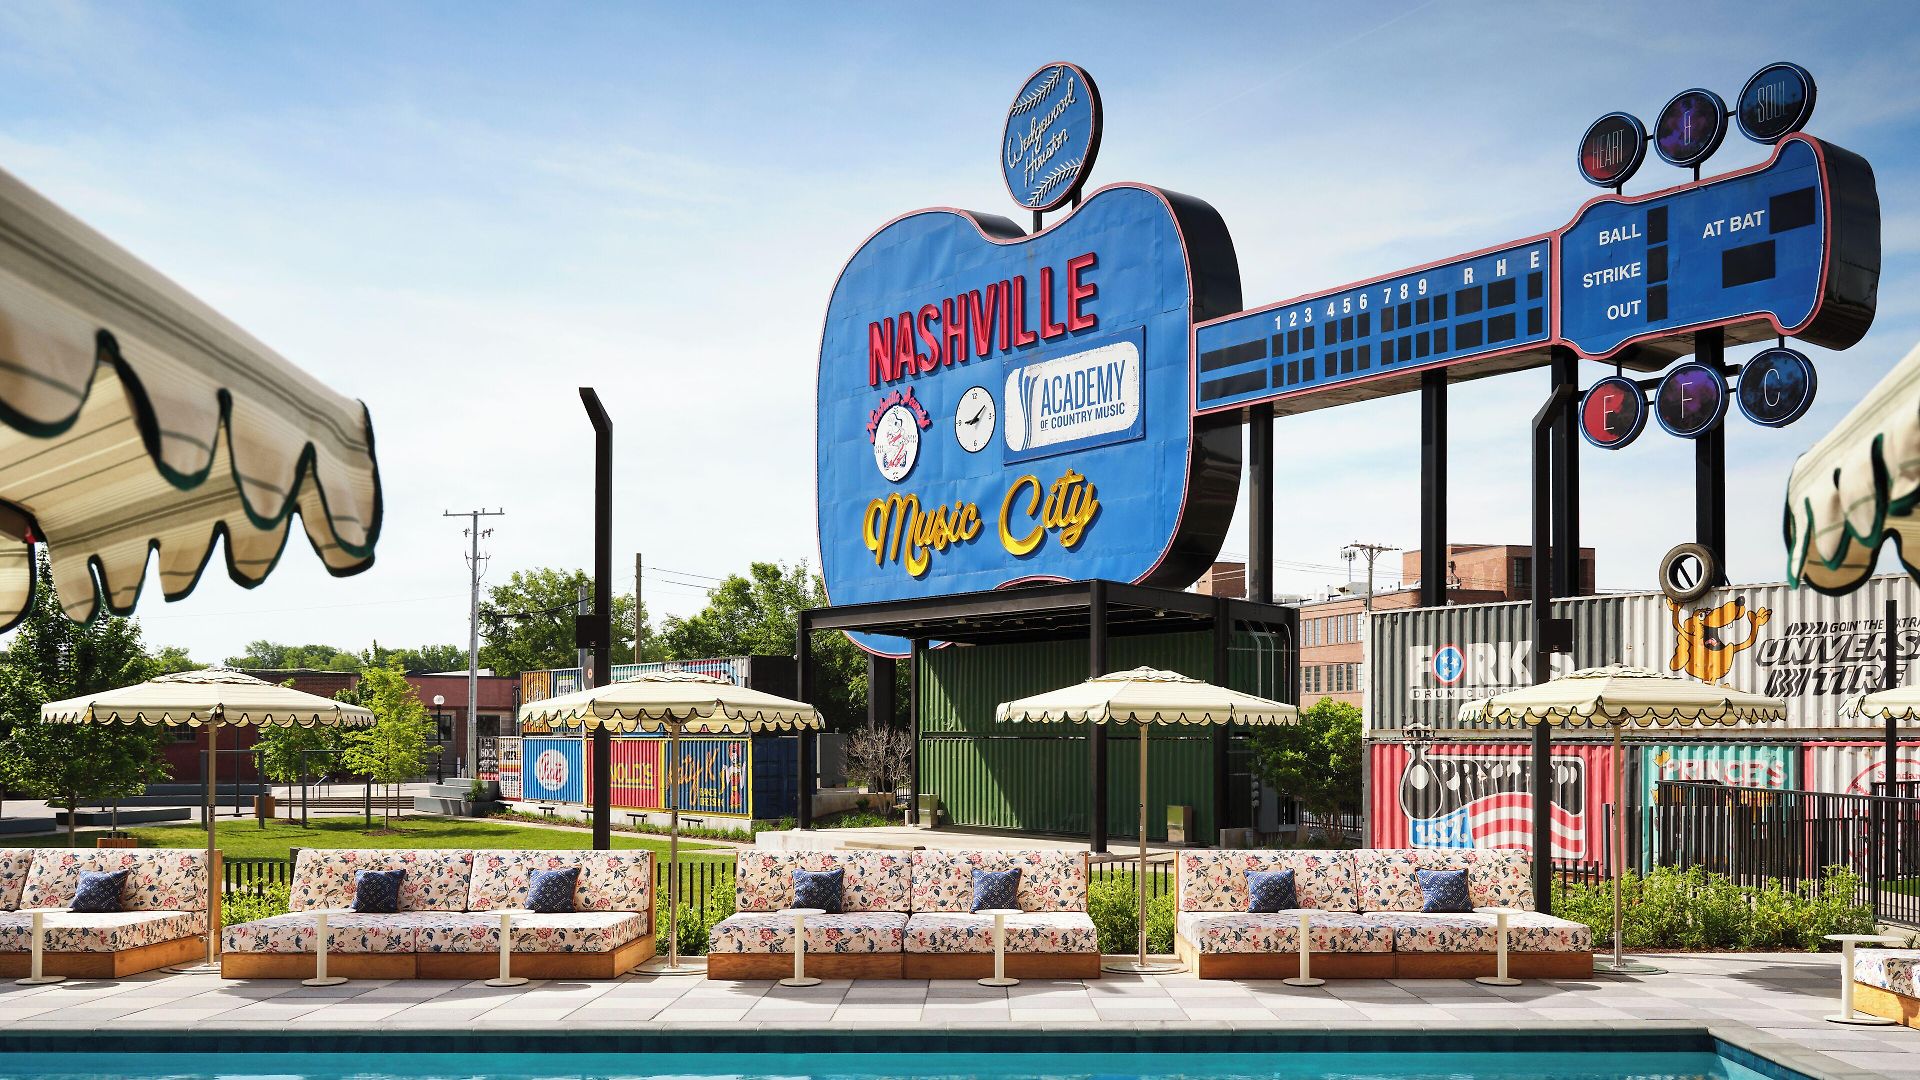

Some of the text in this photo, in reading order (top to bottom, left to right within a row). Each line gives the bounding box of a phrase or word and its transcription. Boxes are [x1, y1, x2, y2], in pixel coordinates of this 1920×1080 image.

[1757, 81, 1786, 124] SOUL
[1592, 129, 1625, 171] HEART
[1599, 224, 1642, 246] BALL
[1702, 210, 1765, 239] AT BAT
[1274, 251, 1540, 330] 1 2 3 4 5 6 7 8 9 R H E
[1583, 262, 1641, 288] STRIKE
[869, 252, 1097, 387] NASHVILLE
[1607, 300, 1642, 320] OUT
[1041, 360, 1125, 417] ACADEMY
[1681, 382, 1693, 418] F
[1764, 368, 1781, 407] C
[1040, 402, 1125, 429] OF COUNTRY MUSIC
[1603, 394, 1615, 431] E
[862, 468, 1100, 577] Music City
[1830, 620, 1861, 633] GOIN'
[1863, 619, 1884, 631] THE
[1413, 689, 1456, 699] DRUM
[610, 762, 654, 786] NOLD'S
[1661, 759, 1787, 788] PRINCE'S
